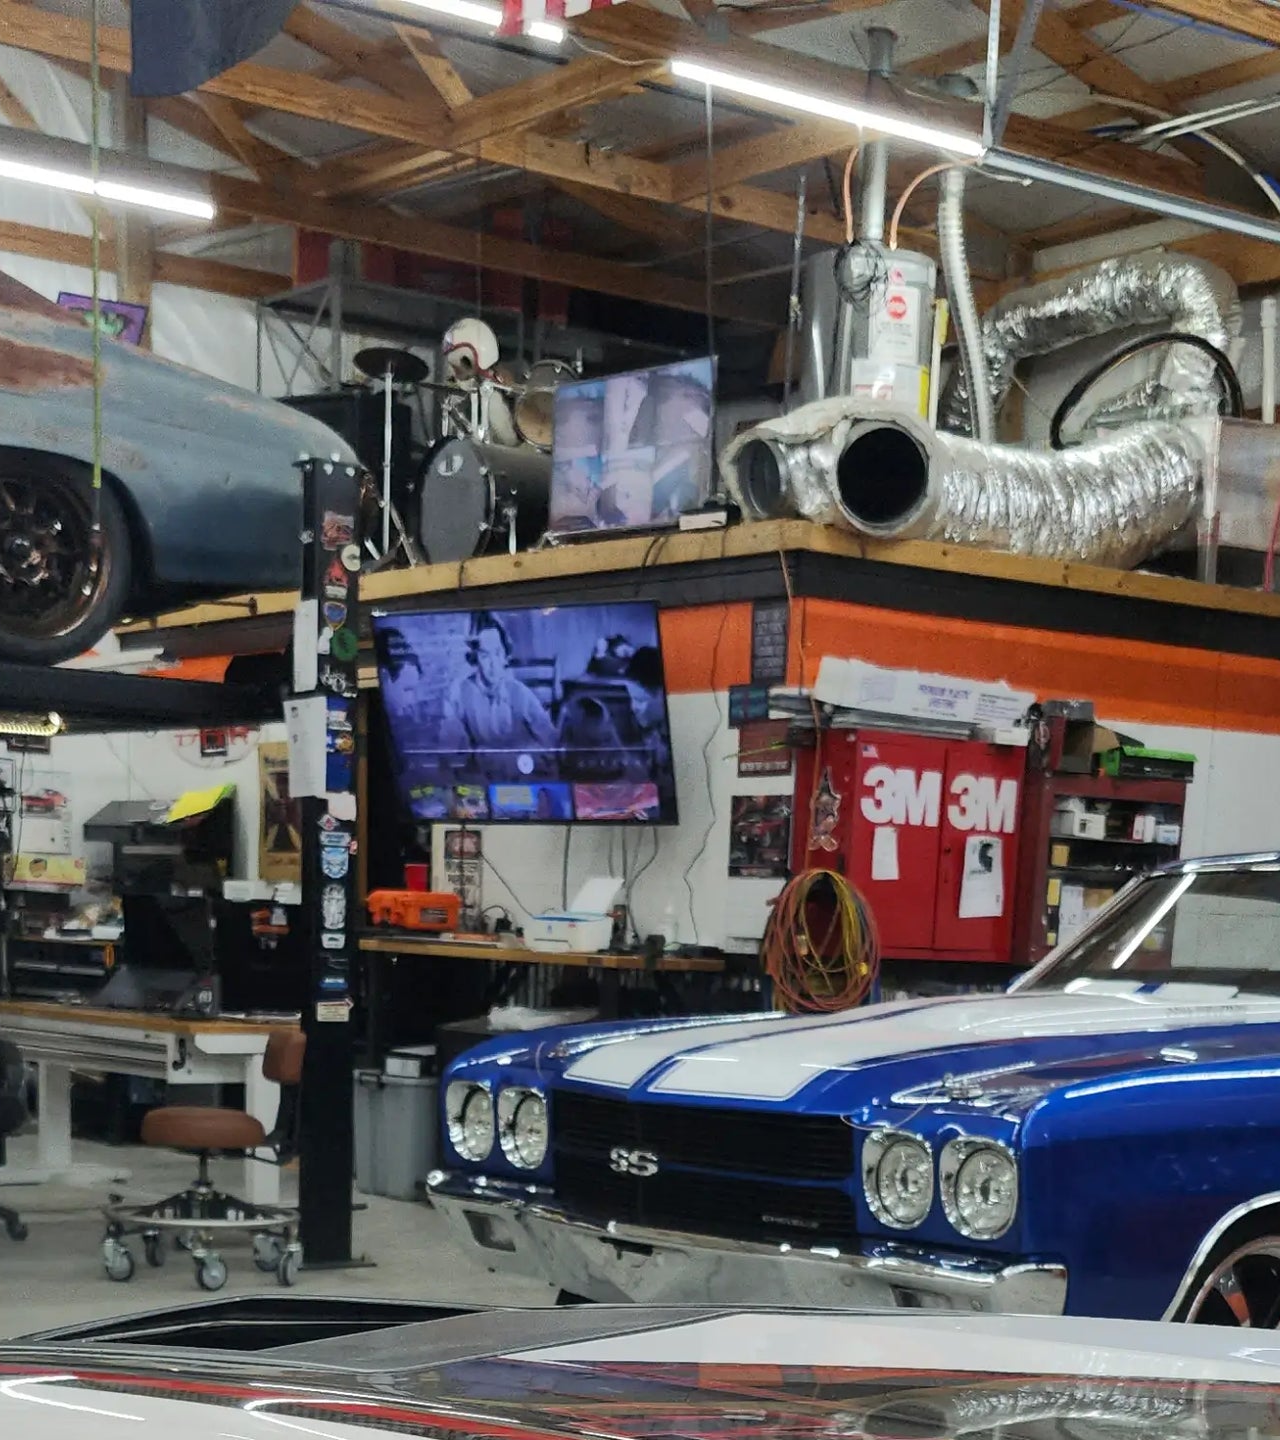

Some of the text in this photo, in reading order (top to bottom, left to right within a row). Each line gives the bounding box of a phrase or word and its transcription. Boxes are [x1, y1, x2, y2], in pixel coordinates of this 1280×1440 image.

[860, 765, 943, 828] 3M
[947, 774, 1018, 834] 3M
[609, 1147, 659, 1177] SS
